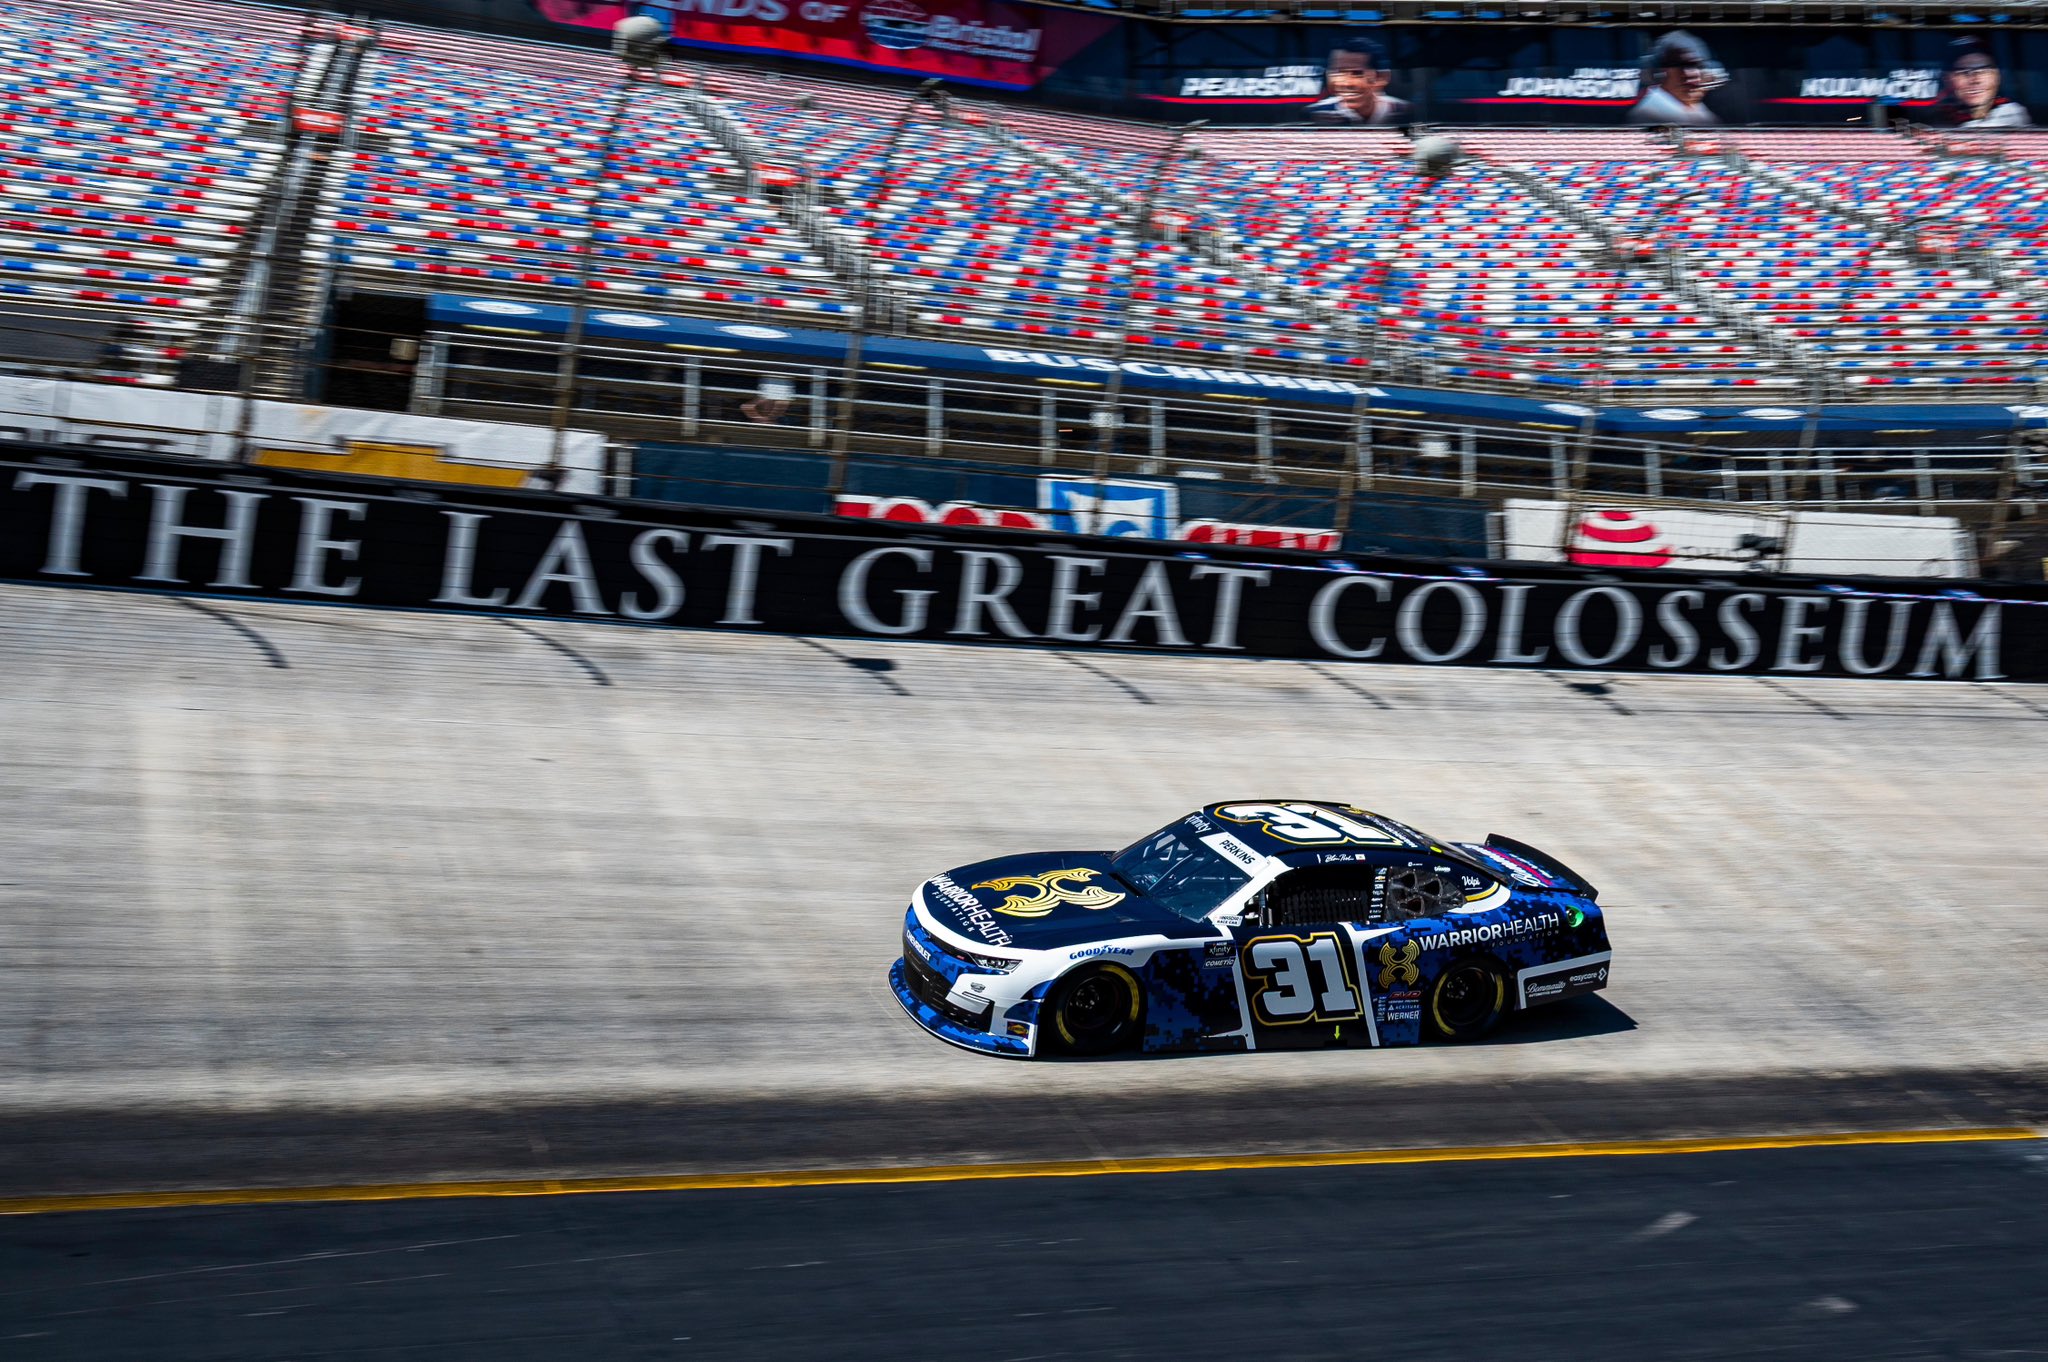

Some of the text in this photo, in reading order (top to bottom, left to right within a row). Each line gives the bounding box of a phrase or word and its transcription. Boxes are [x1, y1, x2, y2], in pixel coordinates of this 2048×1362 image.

[12, 470, 2009, 681] THE LAST GREAT COLOSSEUM
[1223, 803, 1393, 840] 31
[1218, 839, 1257, 865] PERKINS
[1461, 875, 1481, 888] Volpi
[931, 873, 1013, 948] WARRIORHEALTH
[905, 929, 932, 962] CHEVROLET
[1419, 912, 1560, 952] WARRIORHEALTH
[1491, 929, 1560, 948] FOUNDATION
[1069, 945, 1135, 960] GOODYEAR
[1251, 938, 1357, 1016] 31
[1569, 972, 1598, 982] easycare
[1386, 1010, 1420, 1021] WERNER
